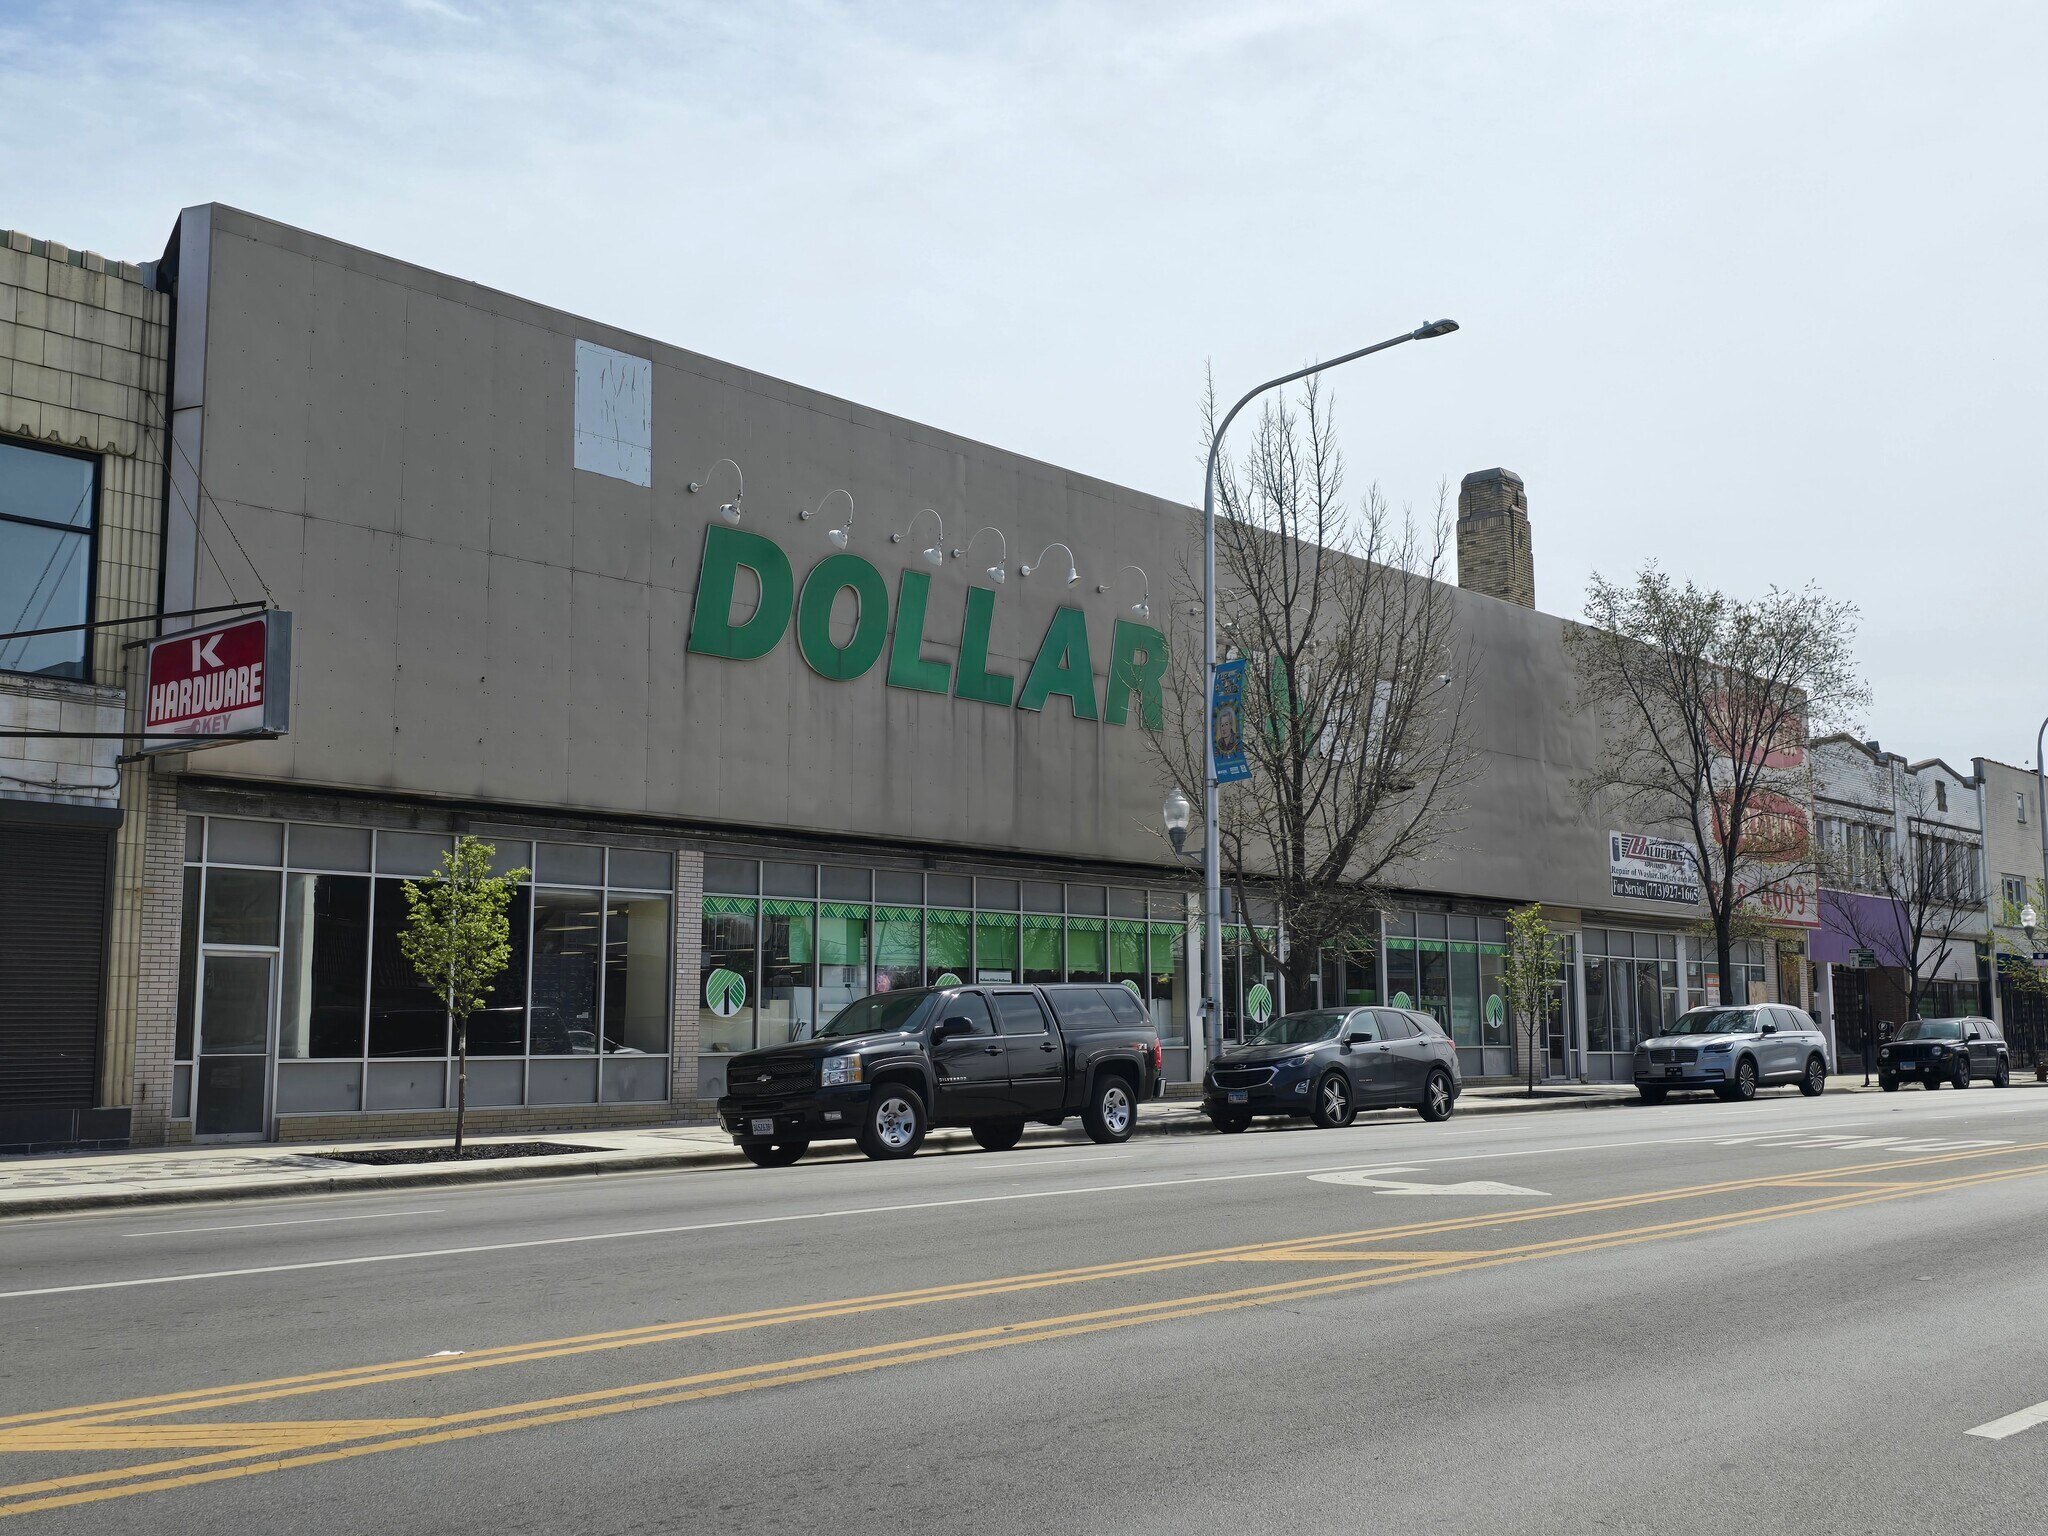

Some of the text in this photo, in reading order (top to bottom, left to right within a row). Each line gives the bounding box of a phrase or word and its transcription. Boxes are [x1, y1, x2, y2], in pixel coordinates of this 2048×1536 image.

[687, 523, 1170, 733] DOLLAR
[191, 633, 225, 672] K
[150, 661, 263, 722] HARDWARE
[202, 713, 232, 734] KEY
[1612, 866, 1630, 877] Repair
[1631, 867, 1637, 876] of
[1613, 880, 1624, 893] For
[1625, 881, 1645, 895] Service
